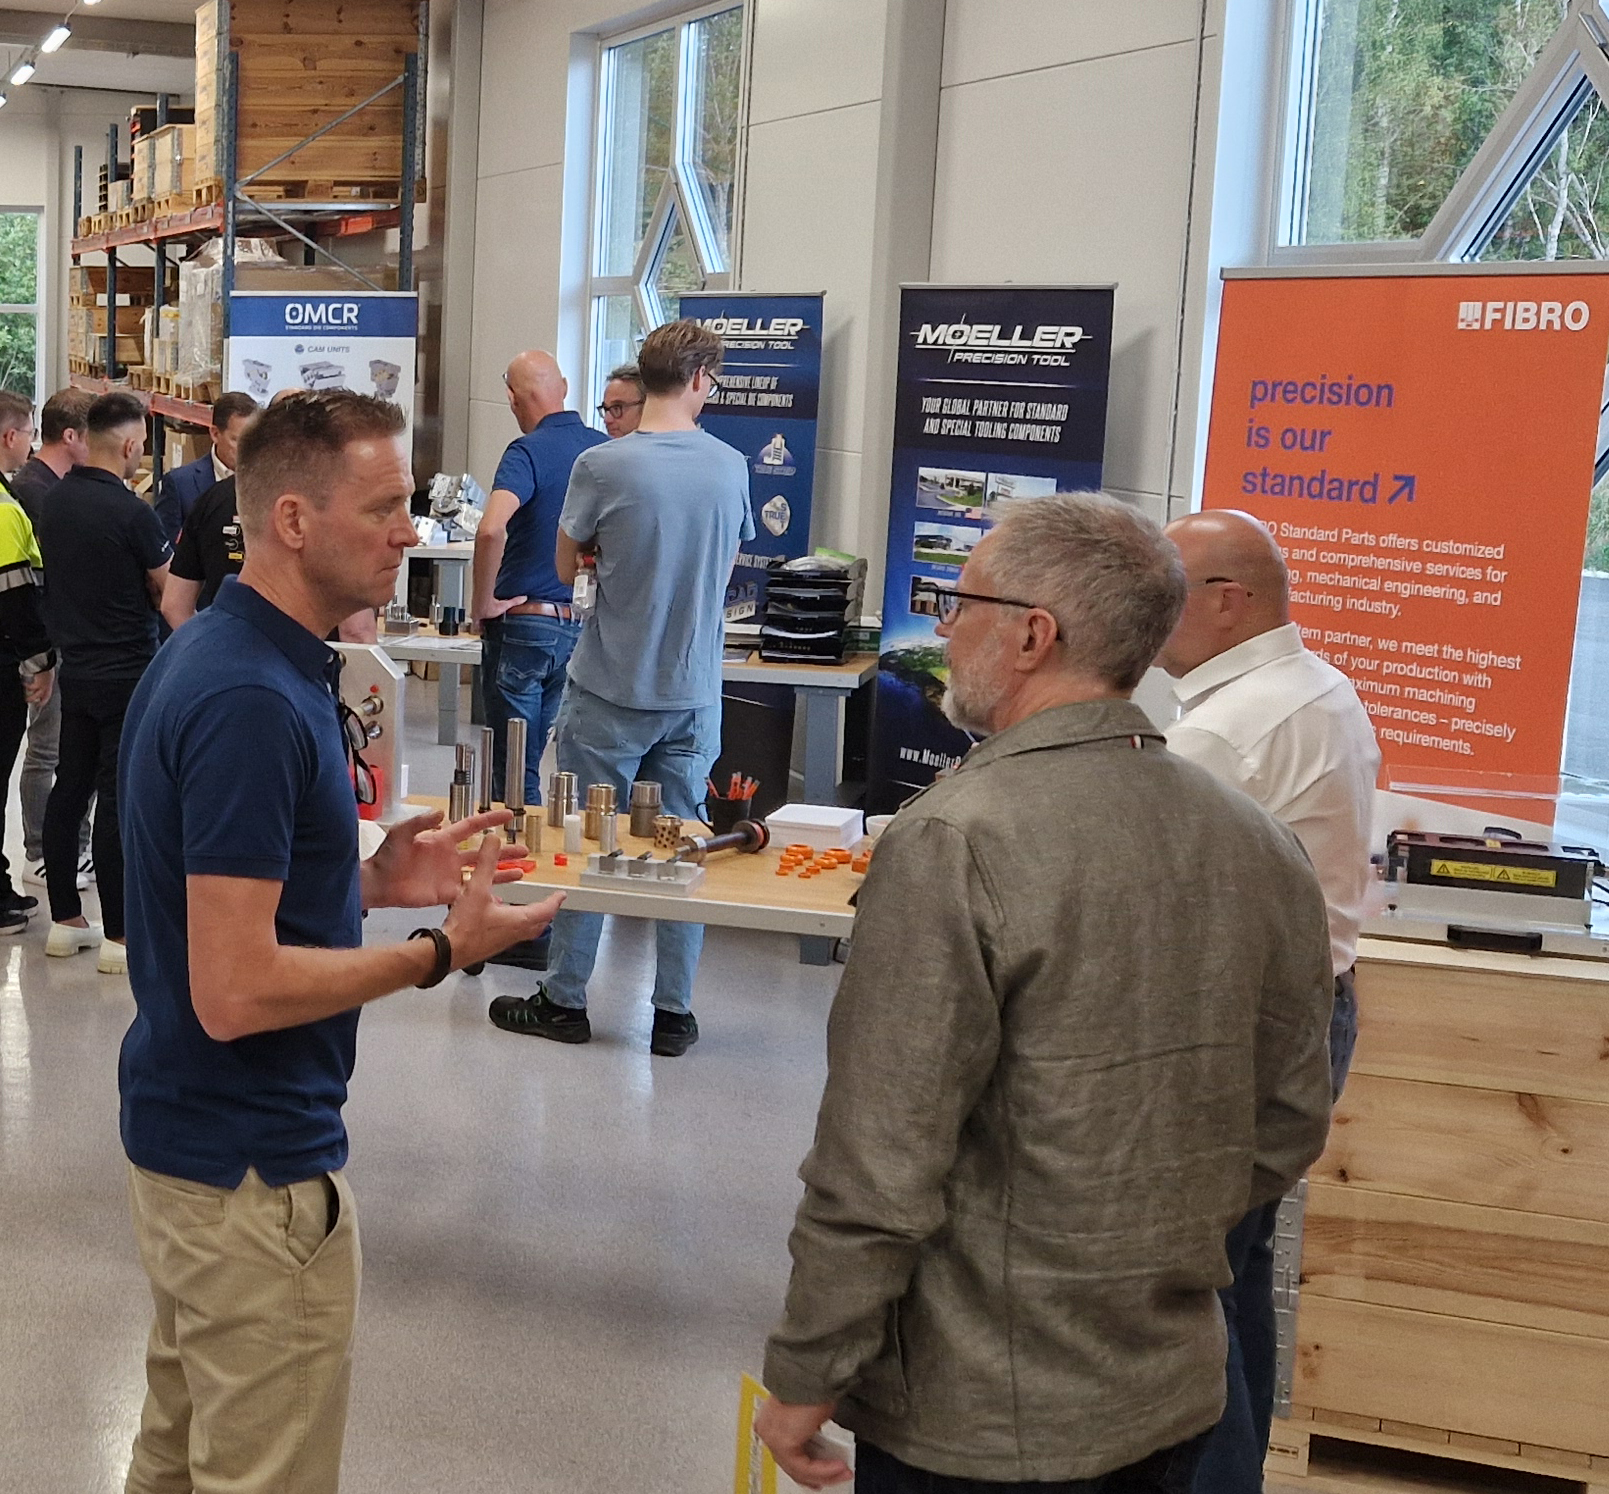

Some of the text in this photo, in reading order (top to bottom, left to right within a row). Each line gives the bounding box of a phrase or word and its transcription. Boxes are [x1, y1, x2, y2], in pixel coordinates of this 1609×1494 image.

[285, 303, 359, 325] OMCR
[1483, 301, 1590, 331] FIBRO
[307, 345, 350, 354] CAM UNITS
[767, 340, 795, 350] TOOL
[916, 323, 1084, 348] MOELLER
[953, 352, 1071, 367] PRECISION TOOL
[725, 391, 748, 406] SPECIAL
[757, 393, 794, 408] COMPONENTS
[1249, 373, 1395, 410] precision
[921, 397, 1069, 422] YOUR GLOBAL PARTNER FOR STANDARD
[923, 417, 1062, 443] AND SPECIAL TOOLING COMPONENTS
[1245, 417, 1332, 452] is our
[1242, 465, 1381, 505] standard
[1280, 522, 1338, 543] Standard
[1341, 528, 1376, 546] Parts
[1379, 532, 1419, 551] offers
[1422, 539, 1505, 560] customized
[735, 553, 753, 568] ERVICE
[1291, 546, 1317, 562] and
[1319, 551, 1422, 573] comprehensive
[1426, 562, 1483, 580] services
[1486, 565, 1508, 583] for
[1288, 587, 1402, 619] facturing industry.
[1307, 571, 1381, 591] mechanical
[1384, 579, 1470, 605] engineering,
[1473, 590, 1502, 606] and
[725, 603, 755, 619] SIGN
[1324, 630, 1373, 651] partner,
[1377, 638, 1398, 652] we
[1402, 641, 1439, 658] meet
[1442, 644, 1464, 661] the
[1466, 647, 1522, 670] highest
[1334, 651, 1348, 665] of
[1351, 655, 1380, 671] your
[1382, 661, 1459, 683] production
[1462, 671, 1493, 689] with
[1349, 676, 1476, 713] aximum machining
[1365, 700, 1437, 726] tolerances
[1451, 717, 1516, 743] precisely
[1380, 727, 1475, 756] requirements.
